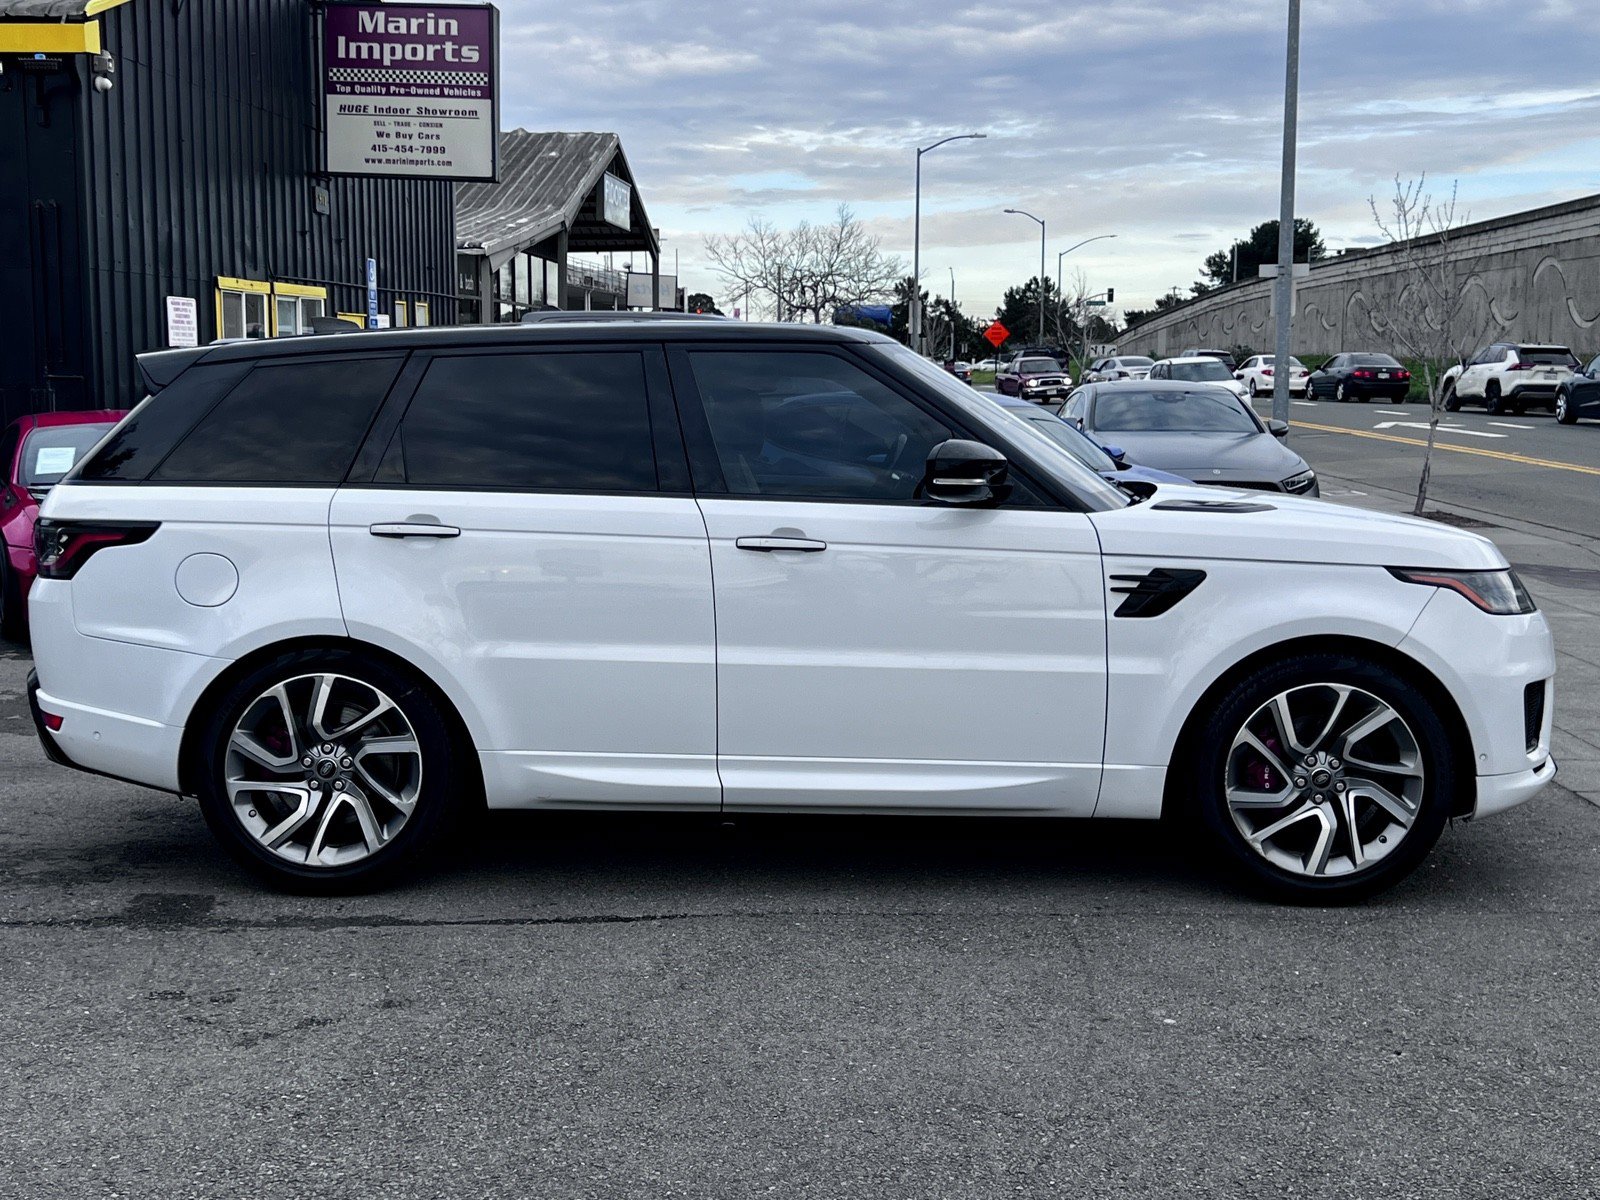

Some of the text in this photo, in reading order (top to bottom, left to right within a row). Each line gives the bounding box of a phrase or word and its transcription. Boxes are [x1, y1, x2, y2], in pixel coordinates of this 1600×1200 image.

[358, 10, 459, 36] Marin
[337, 35, 480, 66] Imports
[336, 84, 482, 97] Top Quality Pre-Owned Vehicles
[339, 104, 478, 117] HUGE Indoor Showroom
[376, 130, 441, 141] We Buy Cars
[370, 144, 446, 154] 415-454-7999
[364, 157, 453, 167] www.marinimports.com
